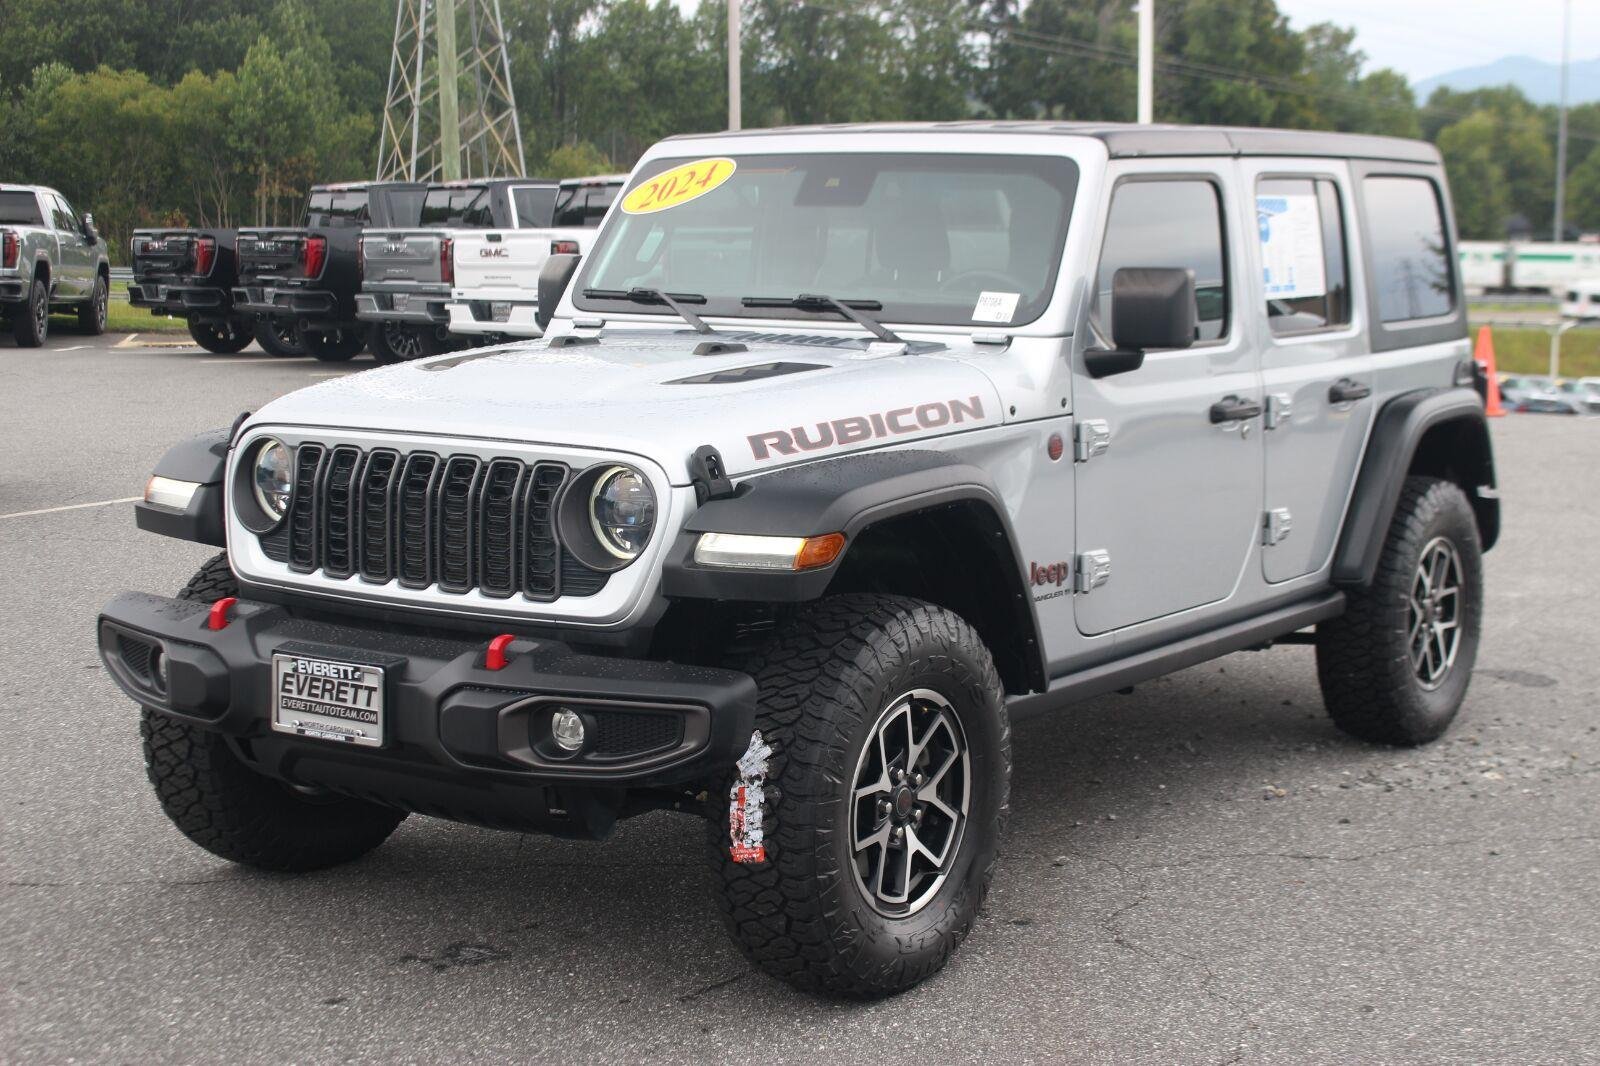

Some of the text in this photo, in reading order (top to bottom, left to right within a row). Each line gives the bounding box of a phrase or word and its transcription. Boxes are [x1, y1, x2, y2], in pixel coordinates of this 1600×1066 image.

[637, 161, 720, 210] 2024
[479, 248, 509, 258] GMC
[746, 395, 986, 461] RUBICON
[1030, 561, 1069, 587] Jeep
[297, 659, 355, 680] EVERETT
[281, 671, 378, 708] EVERETT
[282, 698, 377, 722] EVERETTAUTOTEAM.COM
